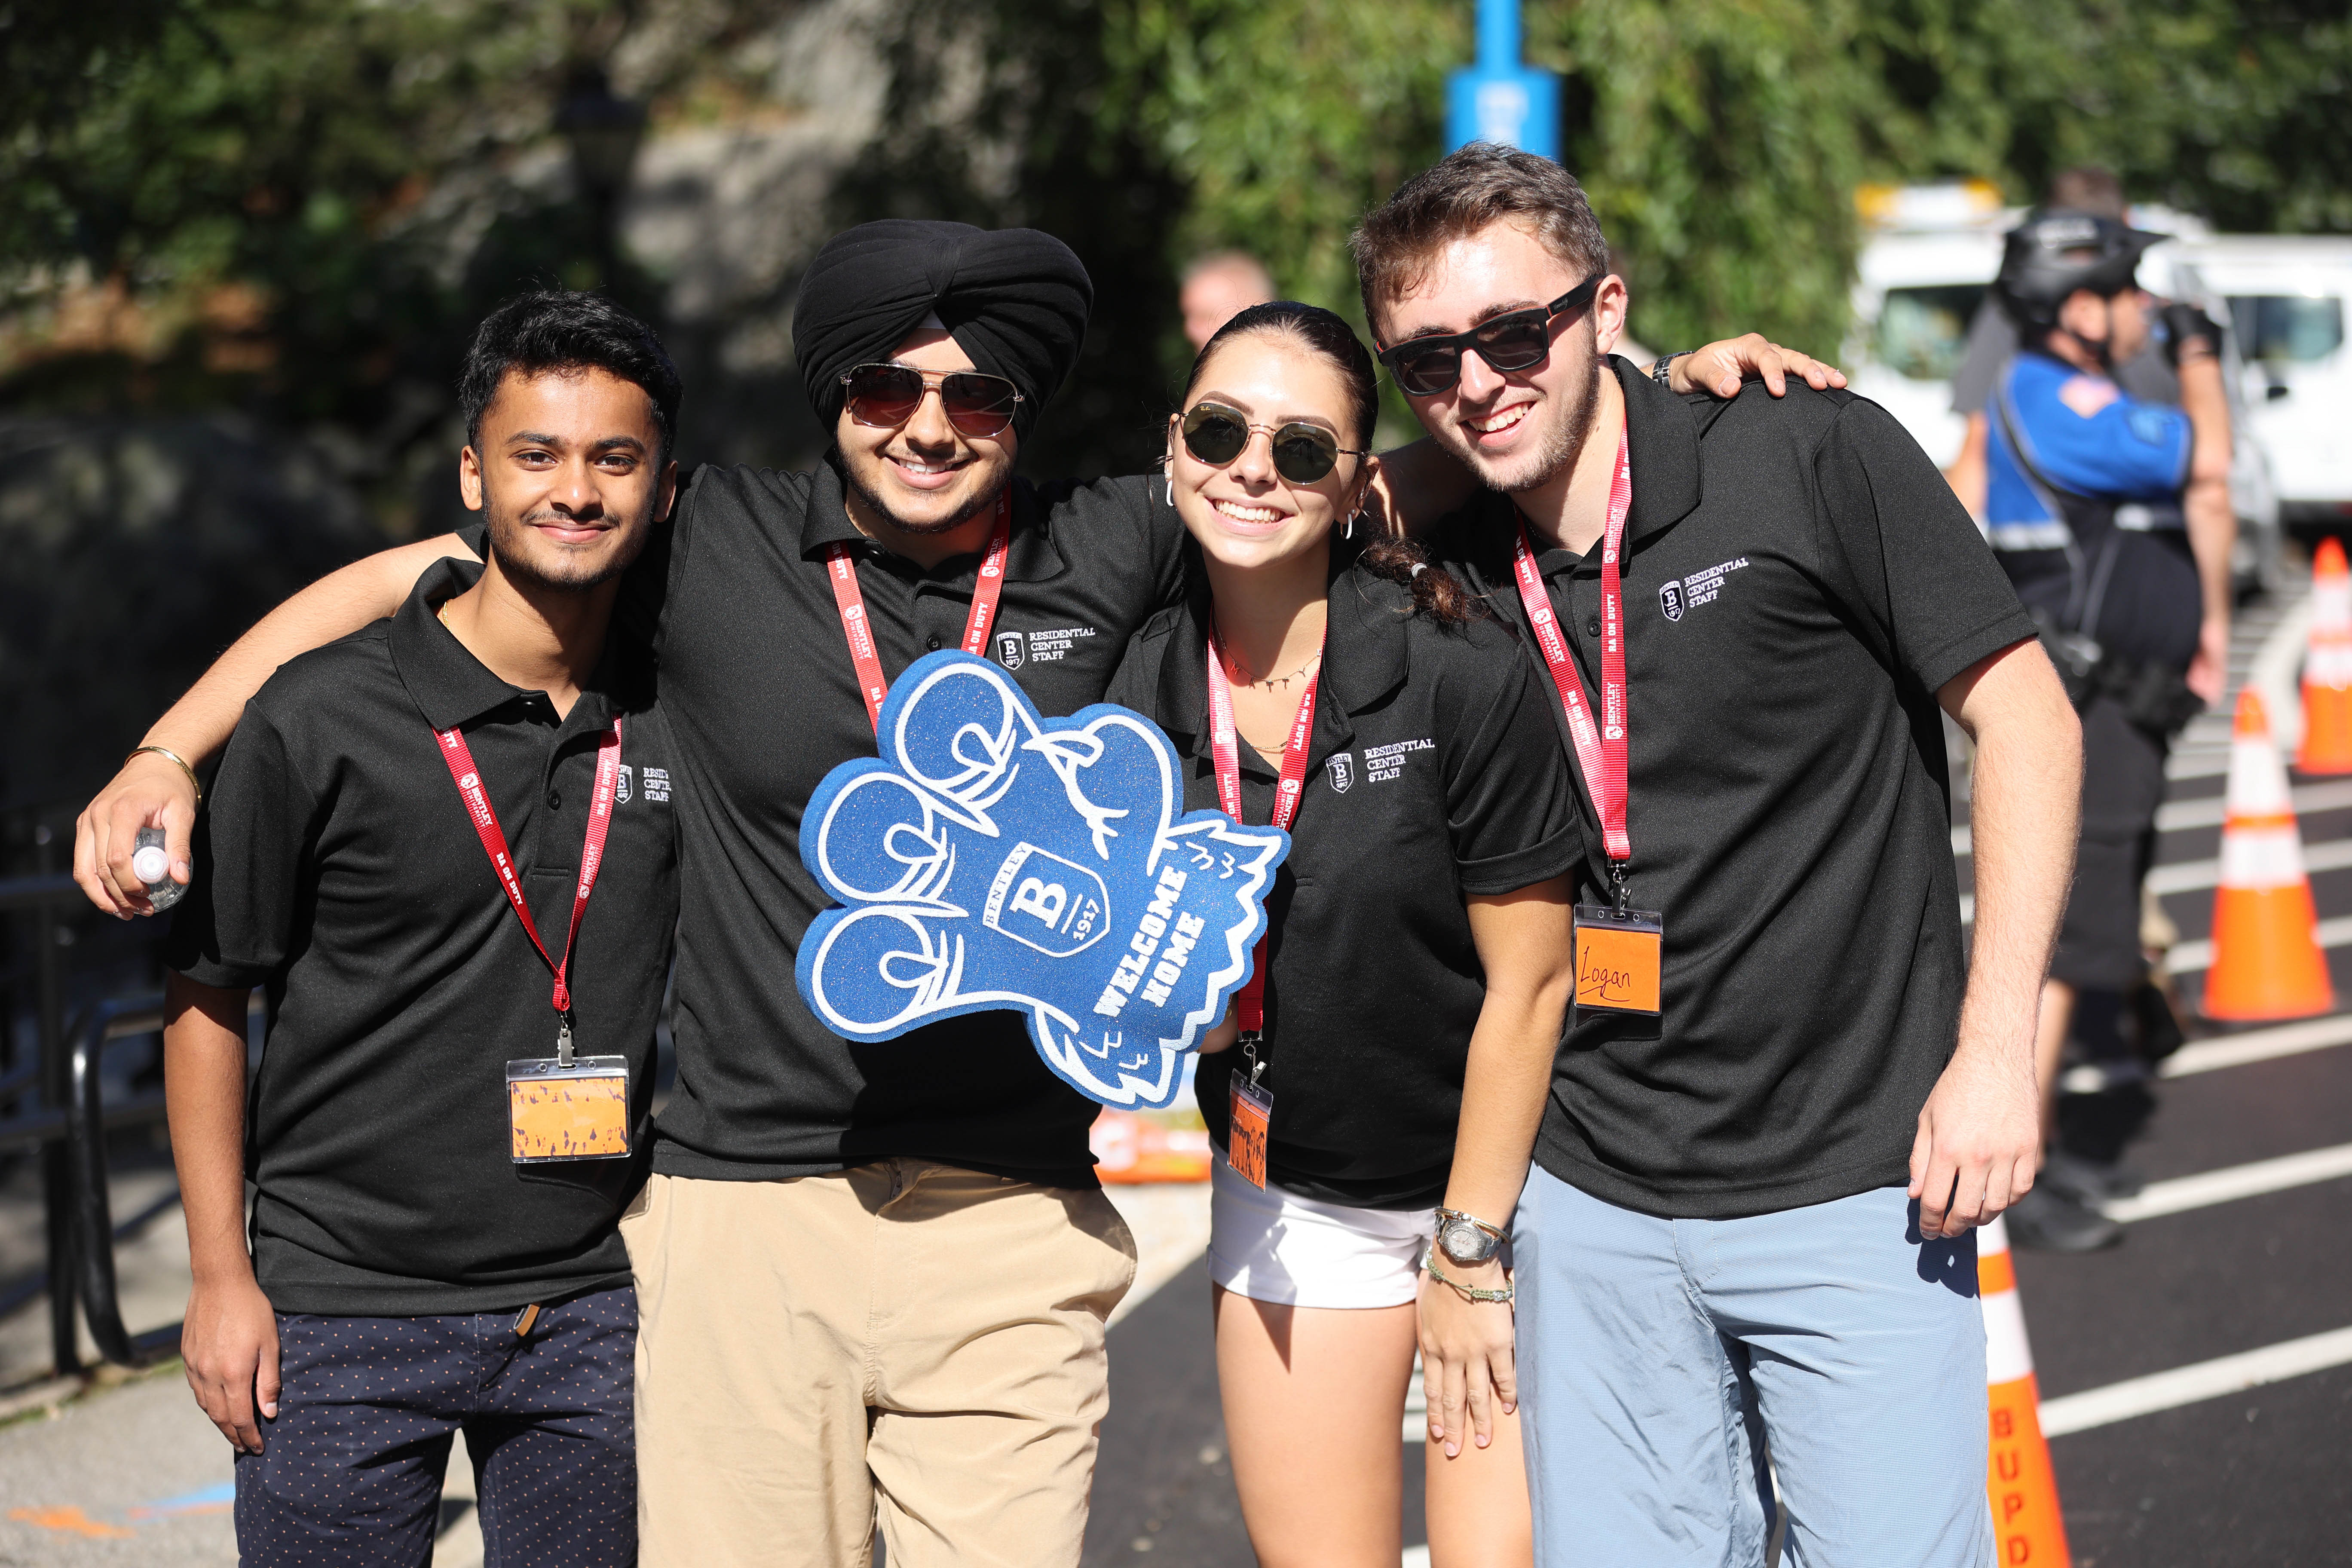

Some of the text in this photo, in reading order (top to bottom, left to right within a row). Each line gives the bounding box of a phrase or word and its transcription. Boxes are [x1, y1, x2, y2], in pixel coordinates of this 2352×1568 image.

[1607, 507, 1618, 548] BENTLEY
[832, 543, 848, 579] ON DUTY
[986, 538, 1000, 566] BENTLEY
[1517, 549, 1525, 561] ON
[1520, 560, 1534, 583] DUTY
[1684, 557, 1749, 587] RESIDENTIAL
[1664, 591, 1677, 606] B
[1687, 576, 1725, 597] CENTER
[1689, 590, 1718, 608] STAFF
[974, 602, 988, 628] DUTY
[1607, 594, 1617, 652] RA ON DUTY
[1668, 608, 1680, 617] 1917
[849, 622, 864, 659] UNIVERSITY
[854, 619, 872, 658] BENTLEY
[971, 630, 981, 643] ON
[1029, 628, 1096, 641] RESIDENTIAL
[1031, 640, 1073, 651] CENTER
[1539, 626, 1557, 663] UNIVERSITY
[1544, 622, 1565, 662] BENTLEY
[1004, 640, 1017, 655] B
[1032, 650, 1064, 662] STAFF
[871, 687, 882, 701] RA
[1567, 690, 1578, 705] RA
[1607, 682, 1616, 725] BENTLEY
[1293, 694, 1311, 751] RA ON DUTY
[1572, 705, 1584, 719] ON
[444, 729, 458, 748] UTY
[1364, 738, 1435, 759] RESIDENTIAL
[1327, 756, 1349, 765] BENTLEY
[1333, 763, 1347, 779] B
[1366, 754, 1406, 770] CENTER
[617, 774, 626, 788] B
[644, 779, 672, 791] CENTE
[1223, 774, 1233, 799] DUTY
[1369, 767, 1400, 782] STAFF
[597, 760, 613, 816] RA ON DUTY
[645, 790, 669, 801] STAFF
[466, 791, 486, 827] UNIVERSITY
[471, 787, 493, 825] BENTLEY
[1227, 802, 1235, 815] ON
[583, 844, 596, 884] BENTLEY
[496, 852, 523, 905] RA ON DUTY
[986, 845, 1026, 924] BENTLEY
[1009, 877, 1067, 930] B
[1073, 898, 1100, 940] 1917
[1093, 865, 1187, 1017] WELCOME
[1140, 911, 1205, 1008] HOME
[1580, 946, 1630, 998] Logan
[1992, 1408, 2029, 1567] BUPD
